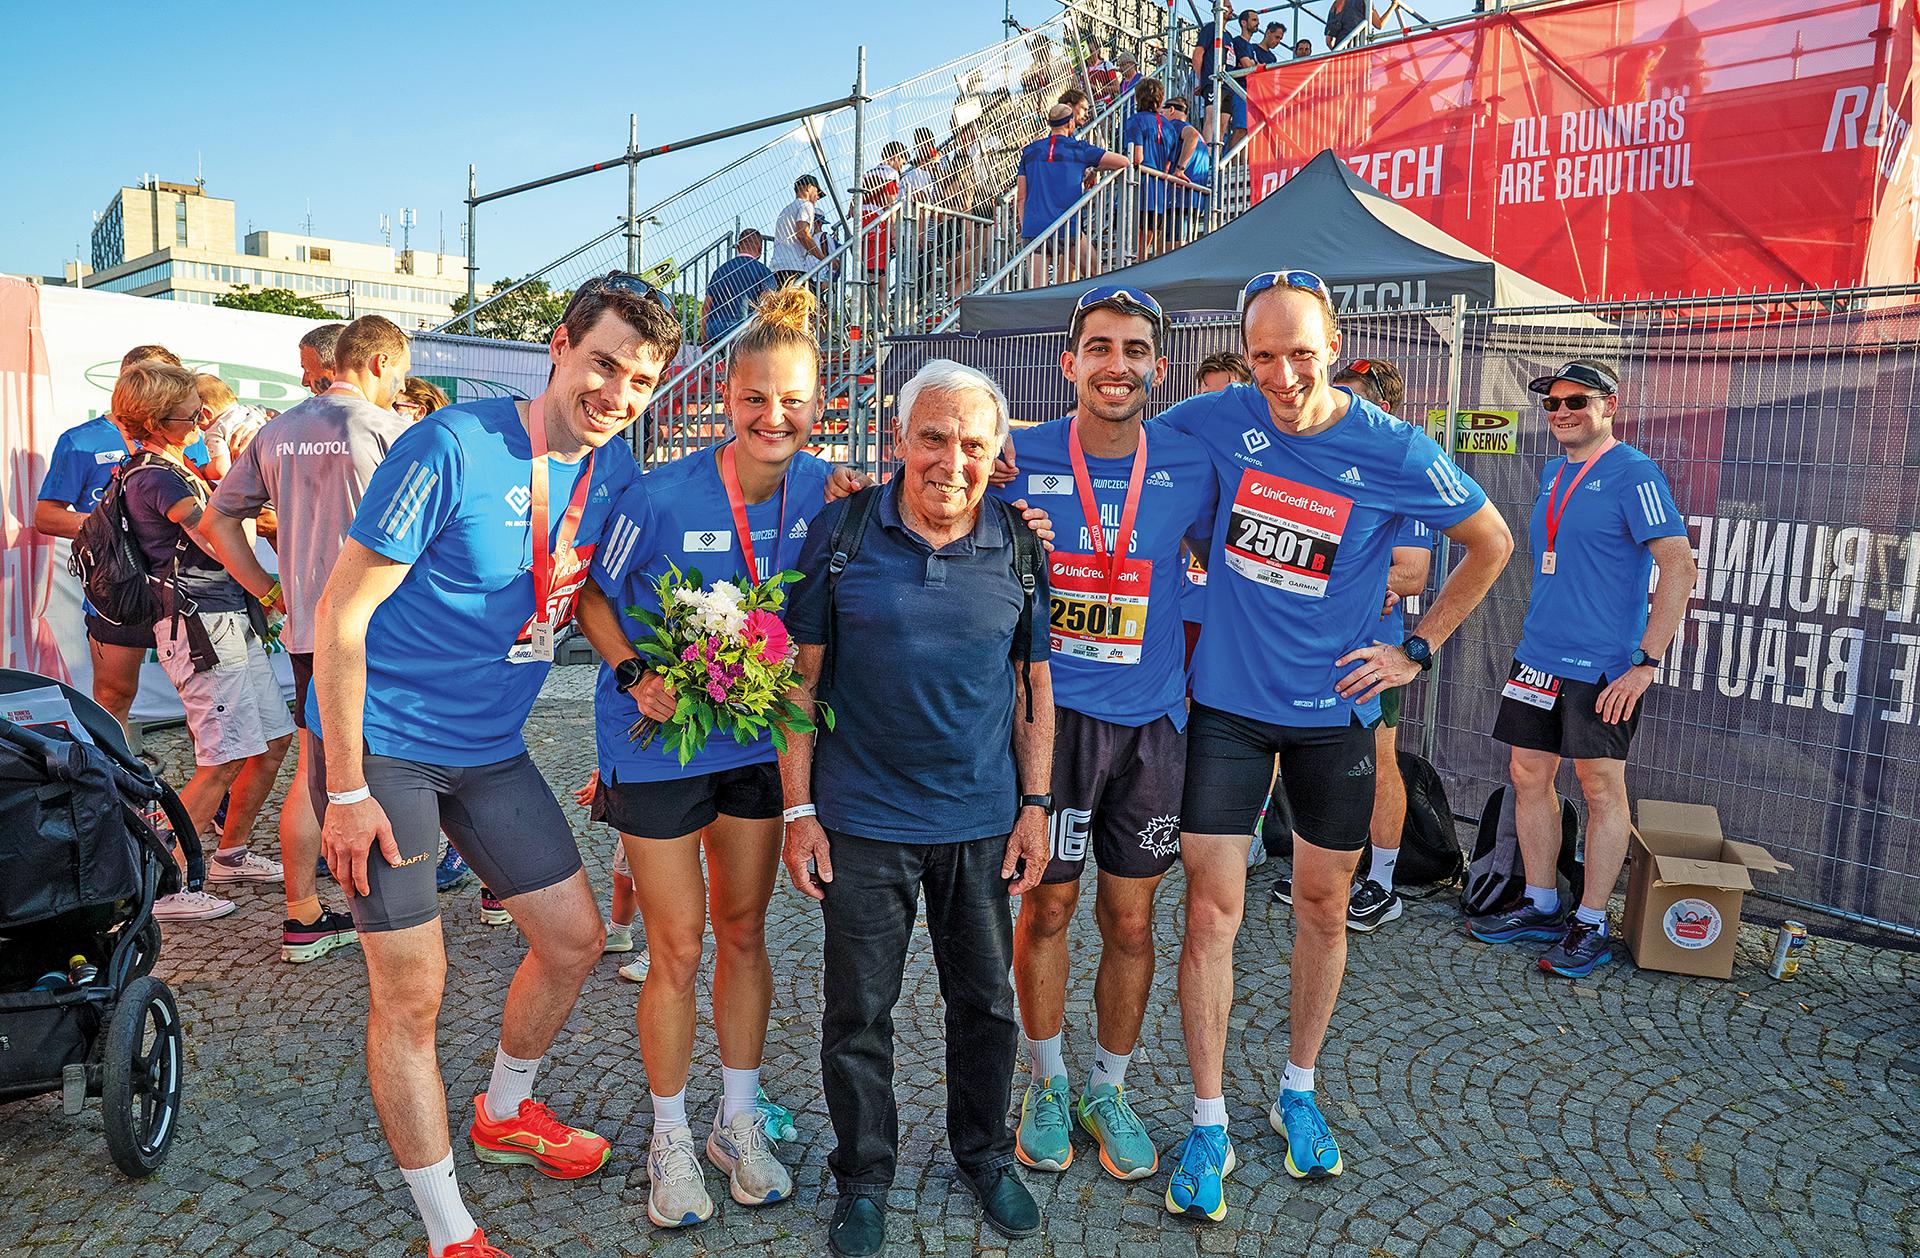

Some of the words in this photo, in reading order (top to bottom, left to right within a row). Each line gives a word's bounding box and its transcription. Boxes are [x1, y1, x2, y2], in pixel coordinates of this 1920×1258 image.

[1510, 115, 1550, 159] ALL
[1560, 95, 1686, 153] RUNNERS
[1498, 160, 1547, 205] ARE
[1555, 143, 1694, 201] BEAUTIFUL
[276, 441, 295, 457] FN
[298, 440, 349, 456] MOTOL
[1435, 431, 1471, 450] JONY
[1243, 455, 1263, 467] MOTOL
[1093, 478, 1129, 490] RUNCZECH
[1146, 478, 1174, 488] adidas
[1262, 486, 1310, 511] UniCredit
[1309, 500, 1337, 518] Bank
[1101, 503, 1120, 527] ALL
[1235, 518, 1314, 568] 2501
[1311, 553, 1326, 571] B
[1118, 571, 1139, 582] ank
[1050, 598, 1122, 636] 2501
[1110, 648, 1123, 656] dm
